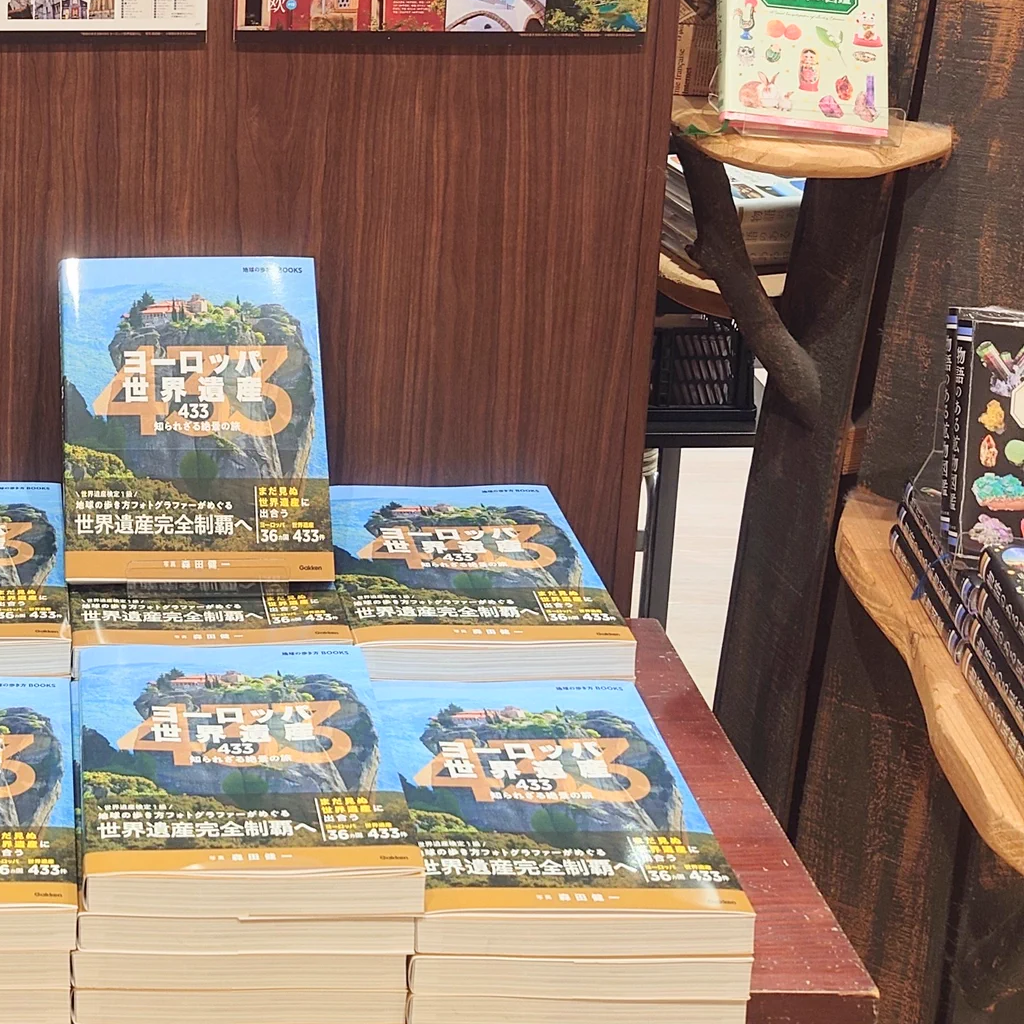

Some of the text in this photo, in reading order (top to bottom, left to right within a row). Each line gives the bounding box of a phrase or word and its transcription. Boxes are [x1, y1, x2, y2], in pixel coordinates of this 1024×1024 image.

[123, 351, 261, 375] ヨーロッパ
[122, 376, 263, 403] 世界遺産
[178, 403, 210, 419] 433
[259, 487, 298, 497] まだ見ぬ
[76, 500, 233, 510] 地球の歩き方フォトグラファーがめぐる
[259, 498, 310, 508] 世界遺産に
[260, 509, 288, 518] 出合う
[74, 514, 252, 535] 世界遺産完全制覇へ
[379, 527, 518, 540] ヨーロッパ
[383, 541, 526, 554] 世界遺産
[181, 560, 231, 569] 森田健一
[443, 554, 474, 562] 433
[81, 610, 264, 624] 世界遺産完全制覇へ
[355, 606, 540, 619] 世界遺産完全制覇へ
[150, 704, 314, 725] ヨーロッパ
[151, 724, 315, 743] 世界遺産
[217, 743, 255, 754] 433
[438, 741, 604, 760] ヨーロッパ
[443, 759, 613, 779] 世界遺産
[515, 778, 553, 791] 433
[96, 819, 316, 840] 世界遺産完全制覇へ
